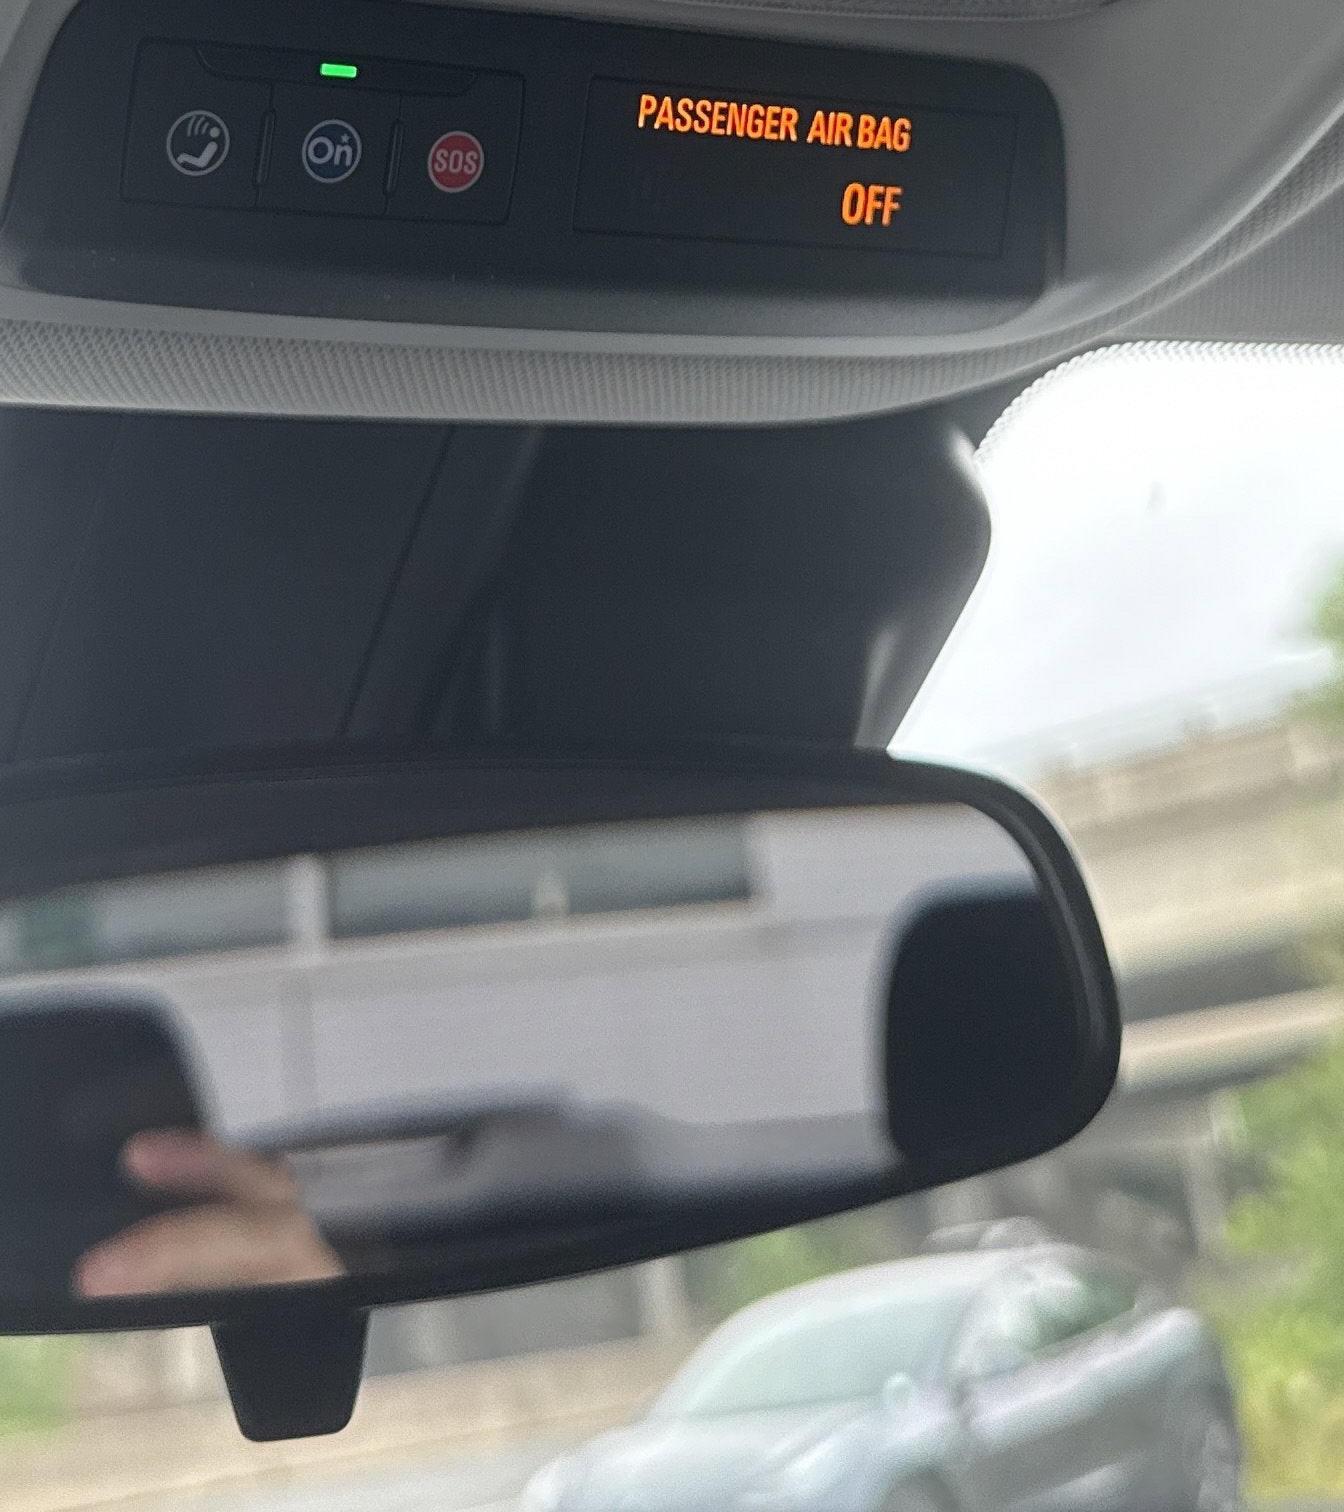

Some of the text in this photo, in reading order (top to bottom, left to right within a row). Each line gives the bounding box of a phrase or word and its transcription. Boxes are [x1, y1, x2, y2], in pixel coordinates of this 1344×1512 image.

[637, 93, 912, 152] PASSENGER AIR BAG
[307, 136, 354, 168] On
[433, 147, 479, 175] SOS
[841, 182, 904, 228] OFF
